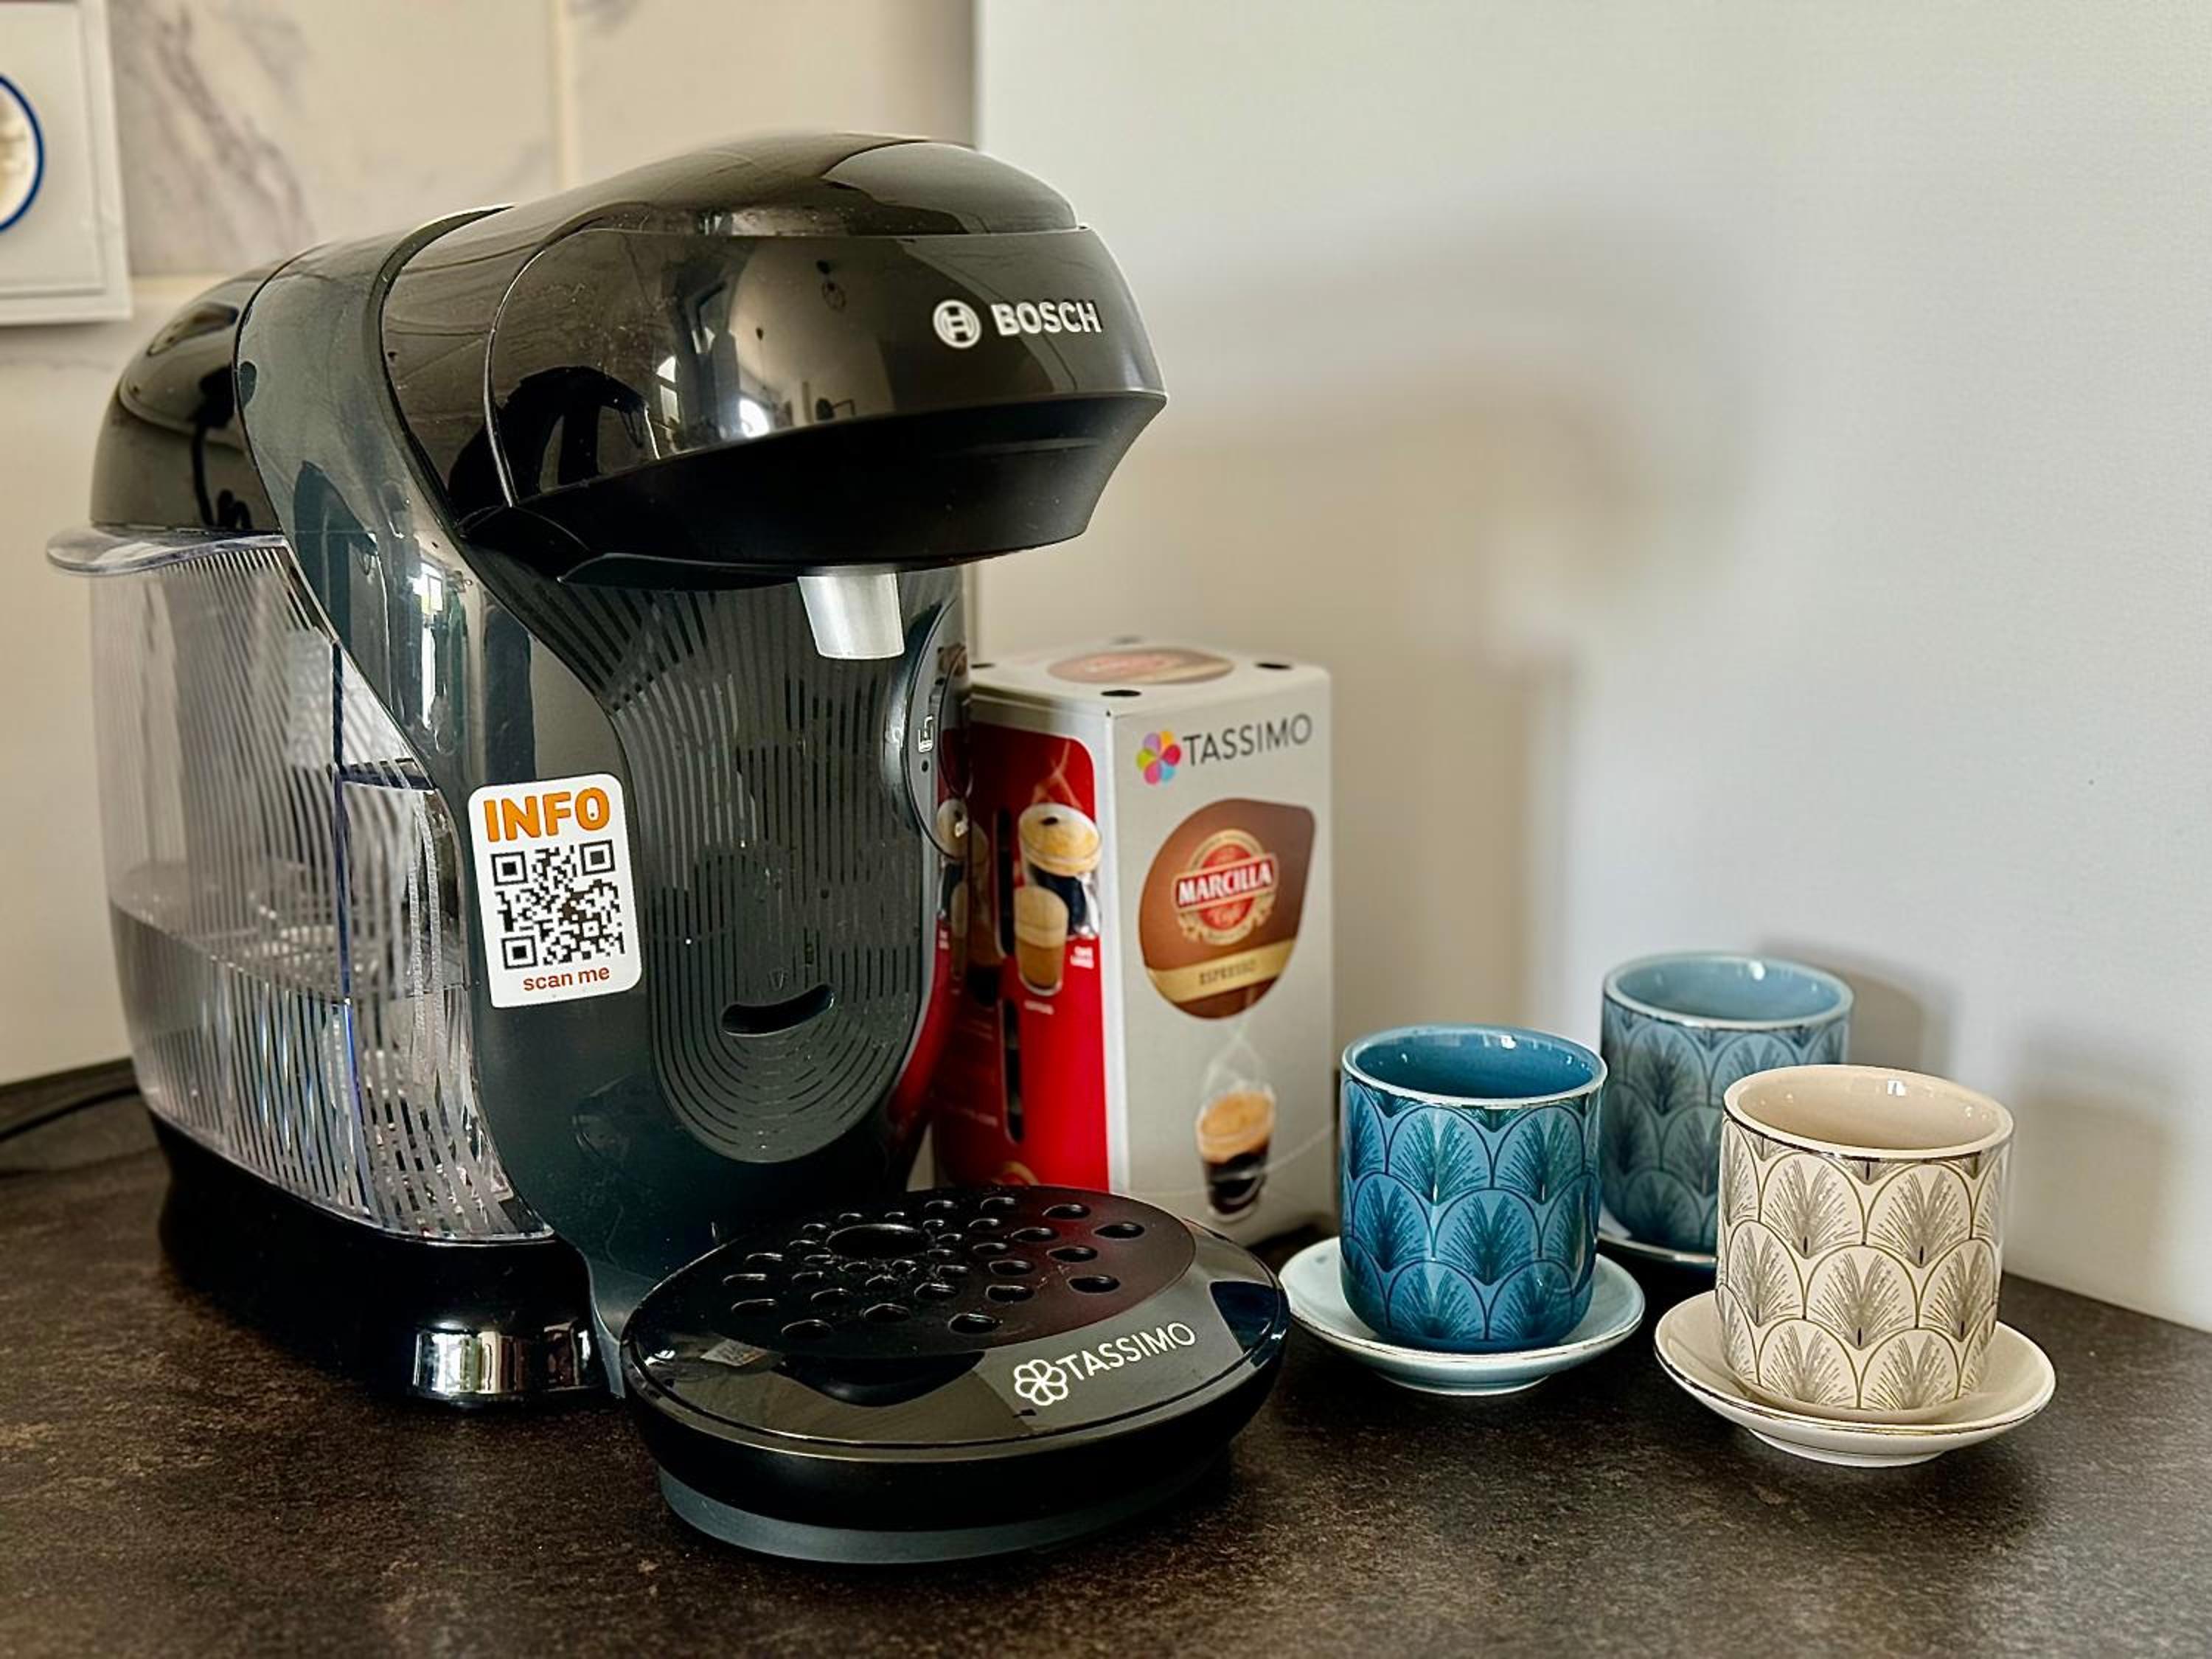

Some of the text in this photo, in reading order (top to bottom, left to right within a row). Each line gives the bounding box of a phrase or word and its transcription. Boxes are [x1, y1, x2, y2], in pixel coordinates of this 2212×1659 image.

[991, 301, 1102, 335] BOSCH
[1182, 713, 1312, 767] TASSIMO
[484, 787, 611, 842] INFO
[1179, 862, 1272, 906] MARCILLA
[523, 967, 611, 991] scan me
[1055, 1322, 1196, 1381] TASSIMO
